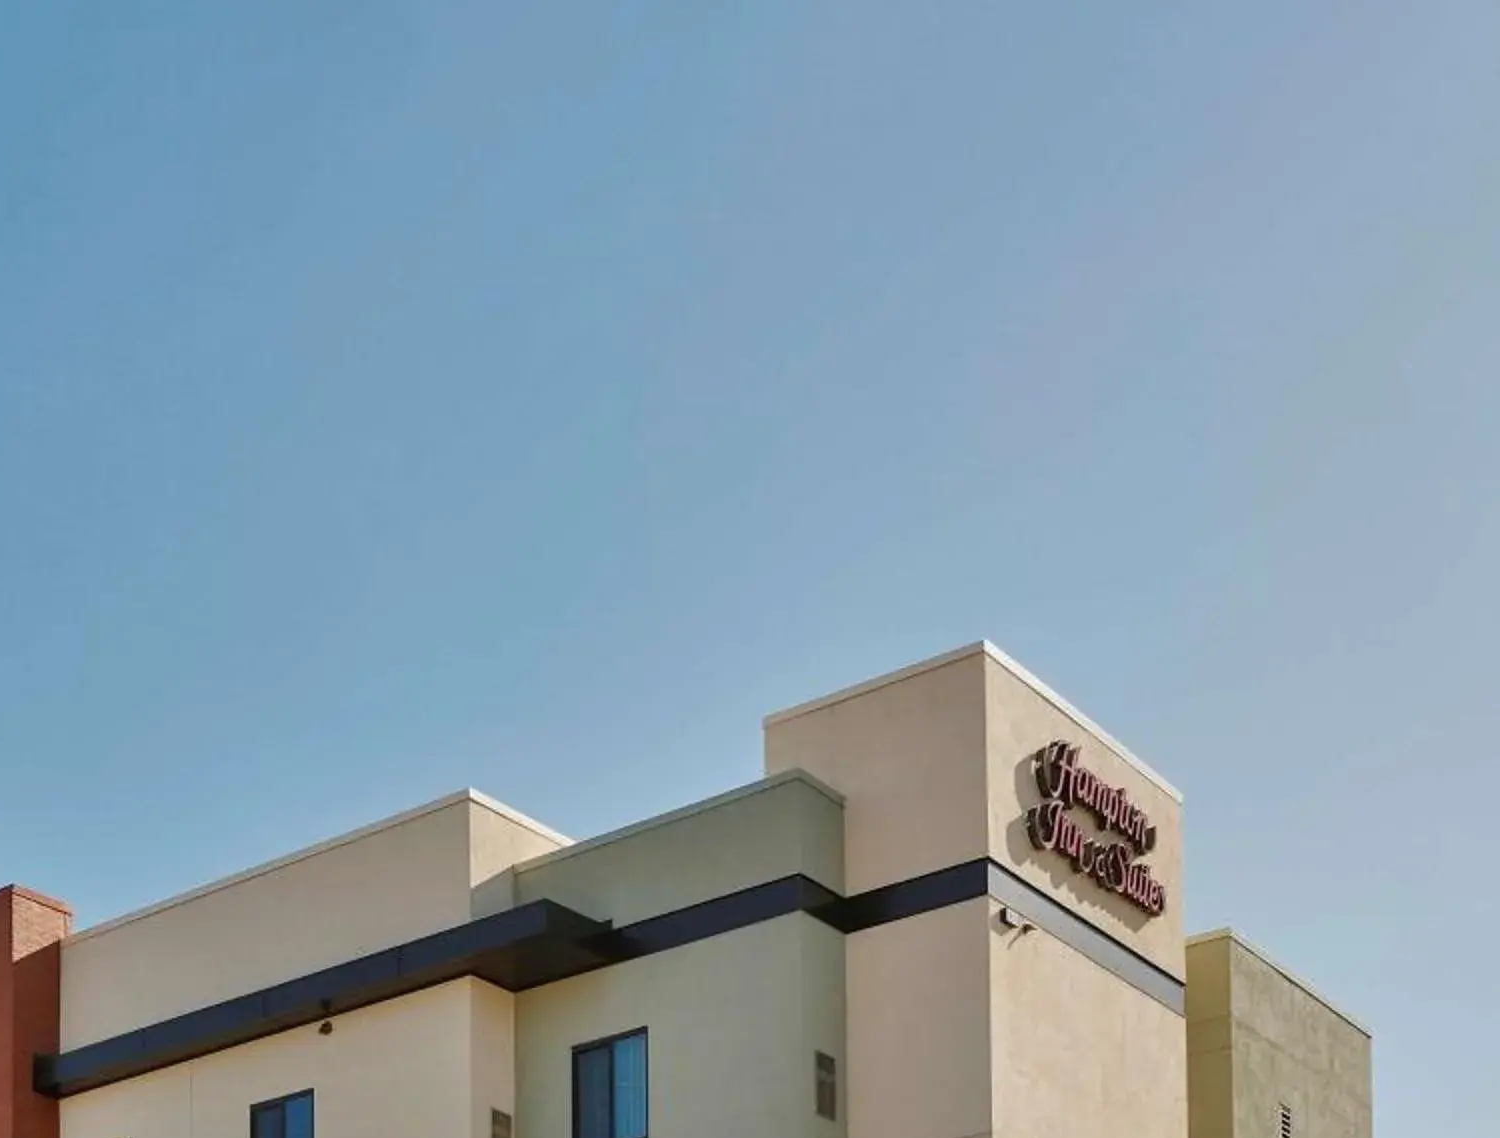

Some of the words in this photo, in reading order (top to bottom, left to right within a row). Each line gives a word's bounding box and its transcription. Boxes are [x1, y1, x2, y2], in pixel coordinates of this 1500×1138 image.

[1032, 739, 1156, 856] Hampton
[1027, 801, 1095, 874] Inn
[1107, 843, 1167, 918] Suites
